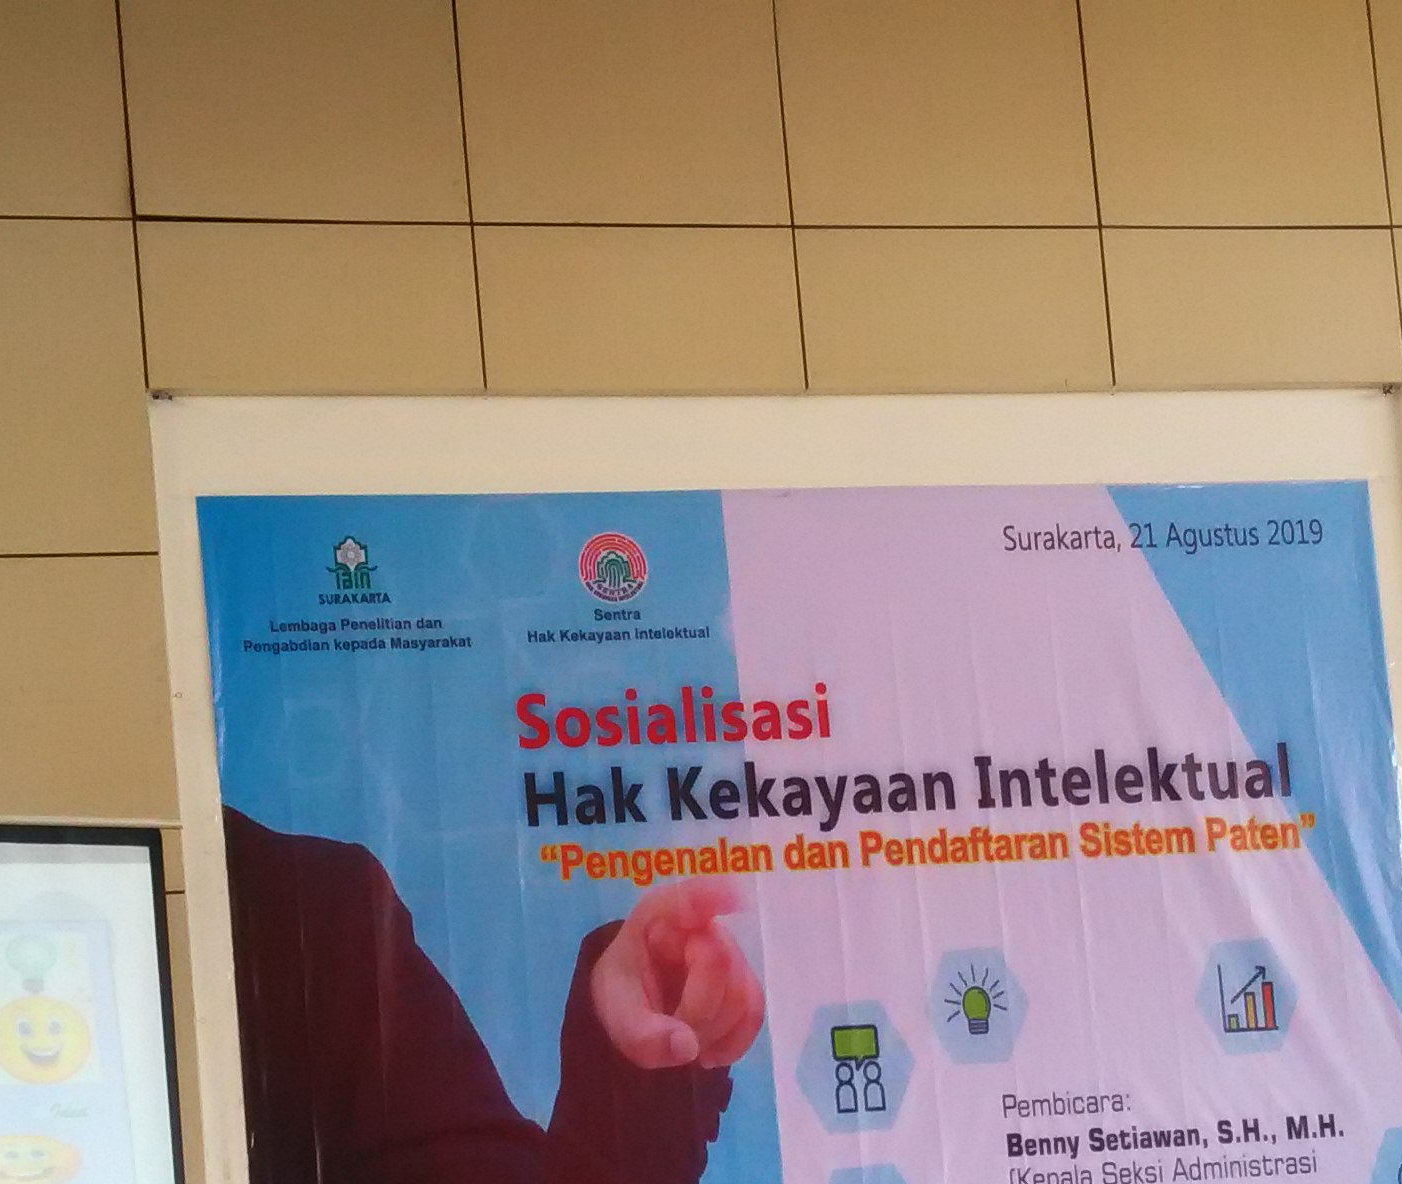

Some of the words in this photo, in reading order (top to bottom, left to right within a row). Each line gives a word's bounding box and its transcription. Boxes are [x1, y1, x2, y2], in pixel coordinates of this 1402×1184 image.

[1002, 523, 1121, 552] Surakarta,
[1129, 522, 1158, 549] 21
[1165, 521, 1260, 555] Agustus
[1267, 518, 1324, 546] 2019
[318, 592, 392, 605] SURAKARTA
[269, 620, 337, 634] Lembaga
[340, 616, 412, 631] Penelitian
[416, 616, 443, 630] dan
[594, 608, 642, 621] Sentra
[243, 640, 330, 655] Pengabdian
[333, 637, 387, 654] kepada
[390, 635, 473, 651] Masyarakat
[527, 630, 557, 643] Hak
[559, 628, 631, 645] Kekayaan
[634, 625, 711, 640] Intelektual
[515, 682, 831, 750] Sosialisasi
[523, 766, 648, 828] Hak
[666, 760, 957, 833] Kekayaan
[973, 741, 1293, 810] Intelektual
[783, 833, 851, 872] dan
[858, 825, 1070, 869] Pendaftaran
[1078, 819, 1197, 860] Sistem
[1002, 1091, 1132, 1119] Pembicara:
[1006, 1133, 1080, 1160] Benny
[1088, 1126, 1209, 1153] Setiawan,
[1217, 1118, 1278, 1145] S.H.,
[1286, 1113, 1345, 1140] M.H.
[1172, 1150, 1318, 1182] Administrasi
